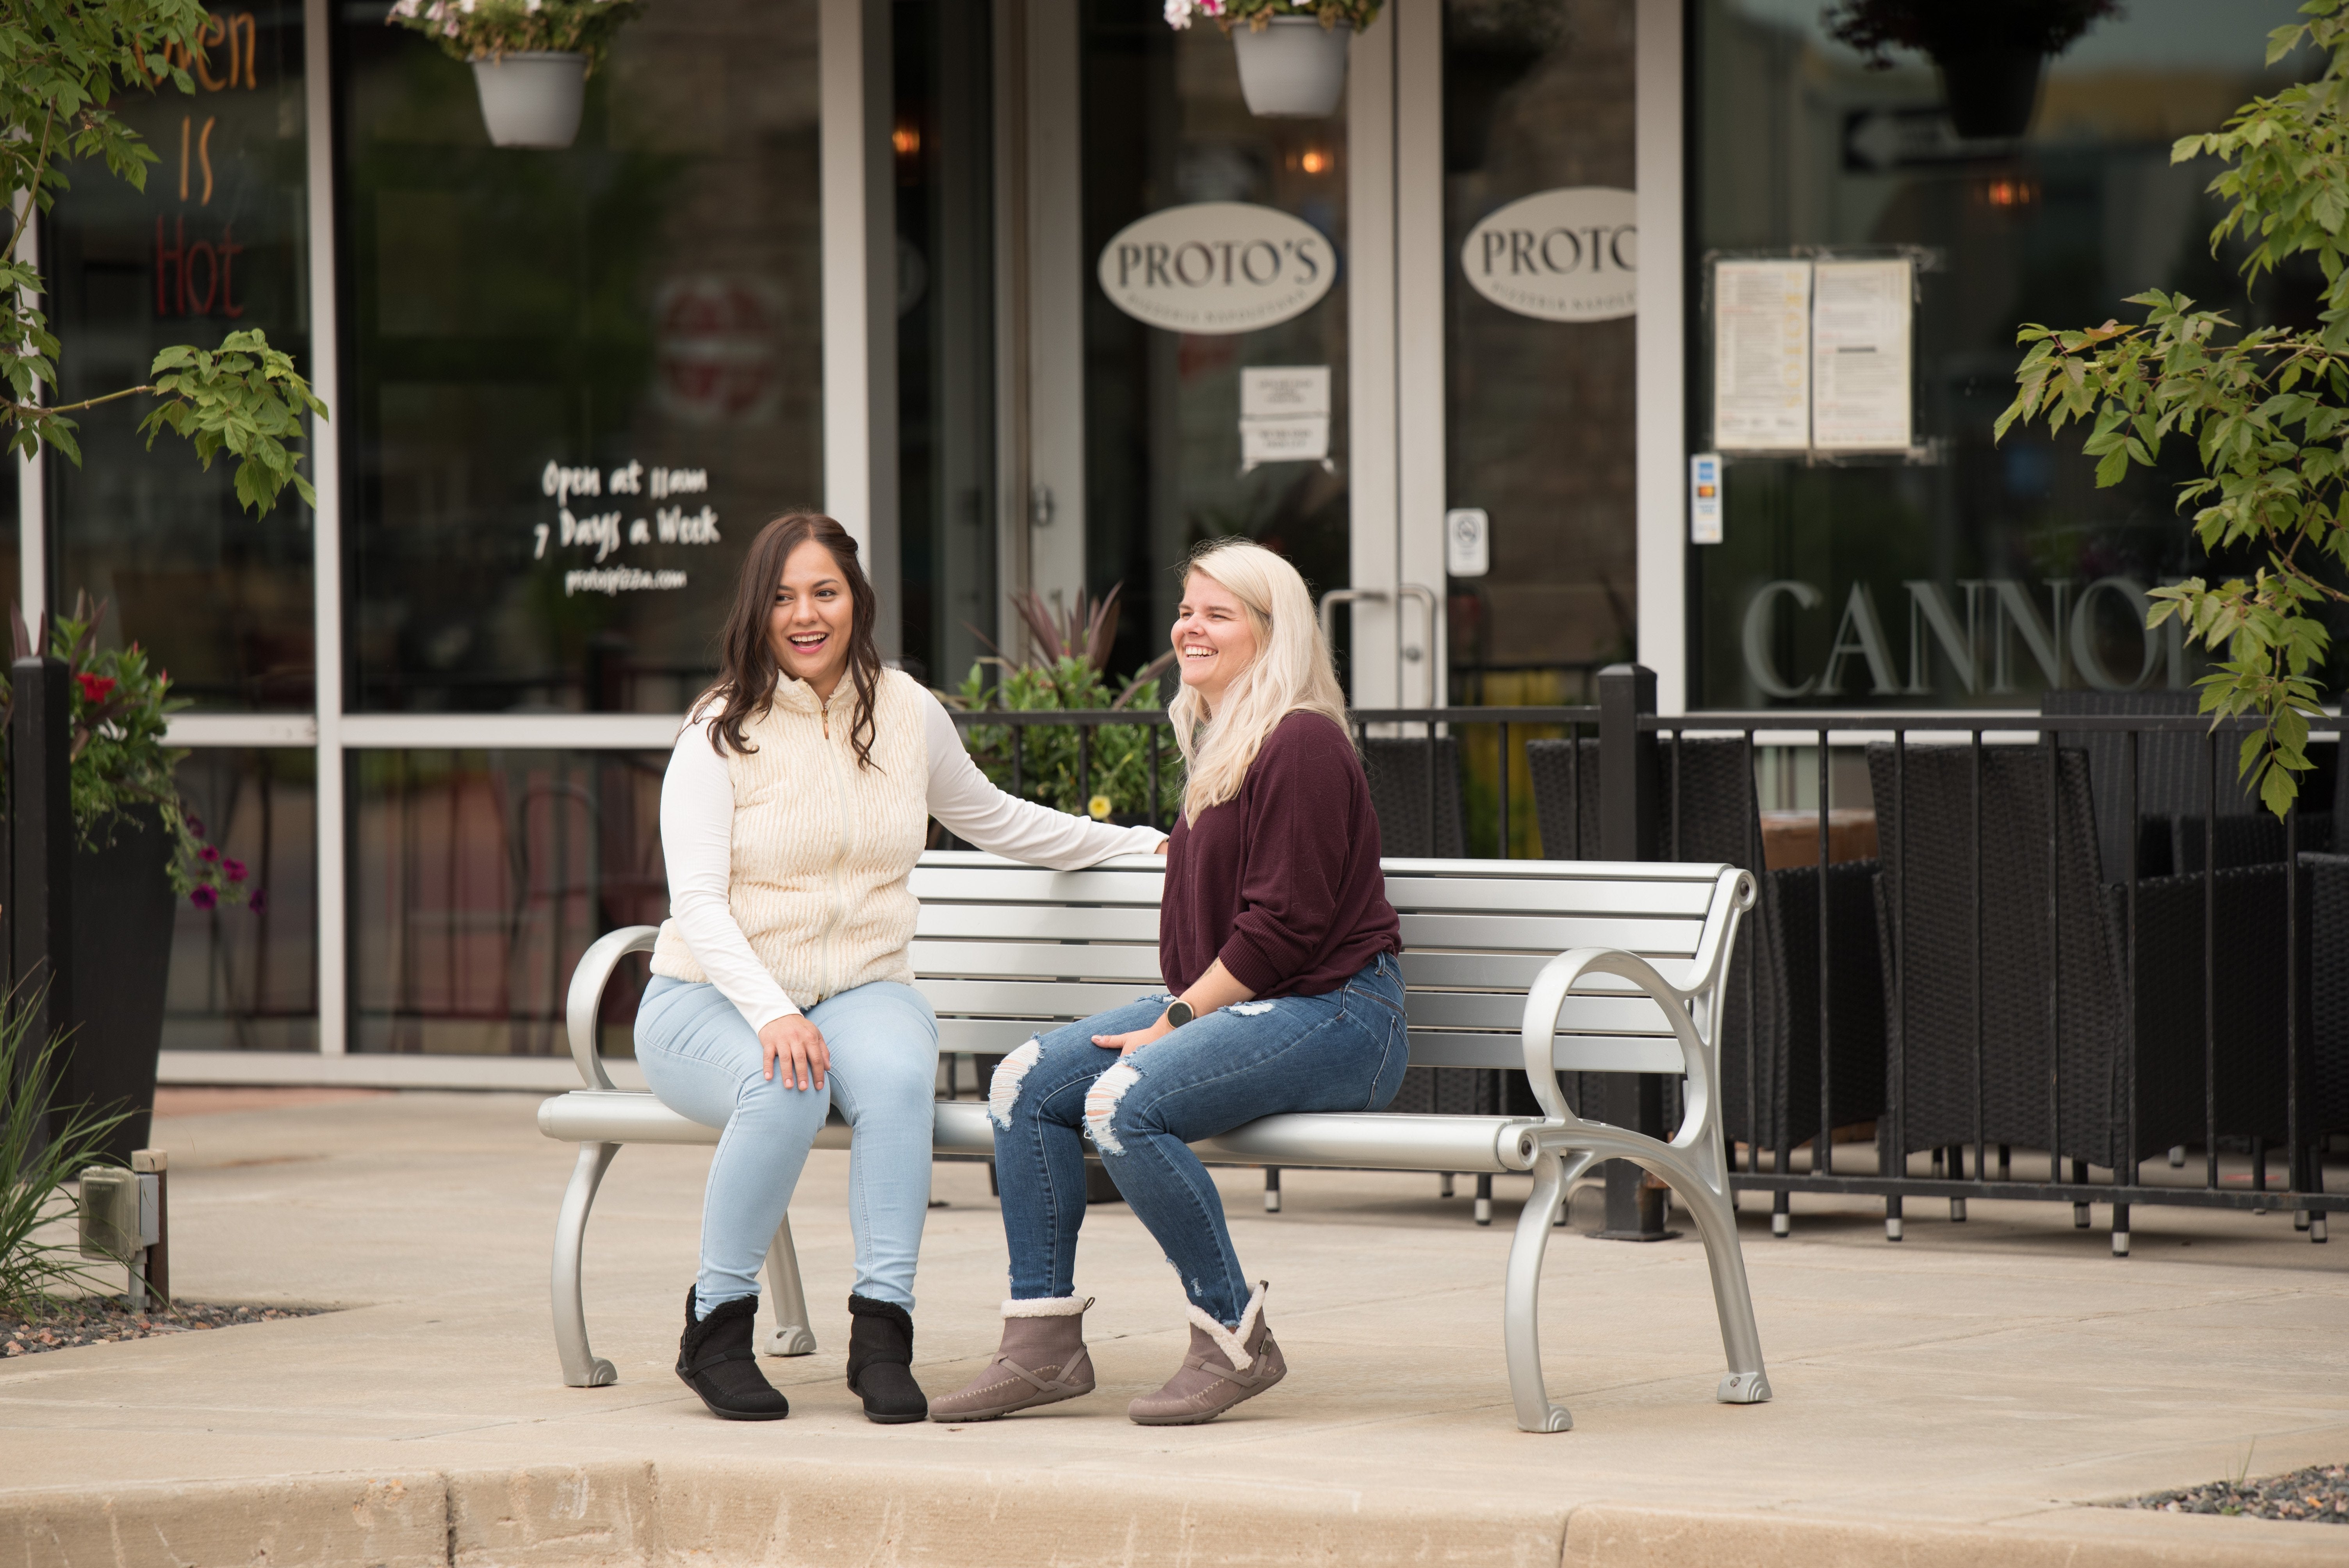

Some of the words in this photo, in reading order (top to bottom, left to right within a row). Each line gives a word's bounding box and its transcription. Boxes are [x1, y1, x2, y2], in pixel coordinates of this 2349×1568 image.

[1117, 237, 1319, 289] PROTO'S
[1482, 223, 1636, 276] PROTO
[542, 460, 601, 508] Open
[609, 458, 643, 495] at
[650, 467, 708, 499] 11am
[534, 523, 550, 559] 7
[559, 508, 622, 563] Days
[629, 518, 651, 545] a
[656, 504, 721, 545] Week
